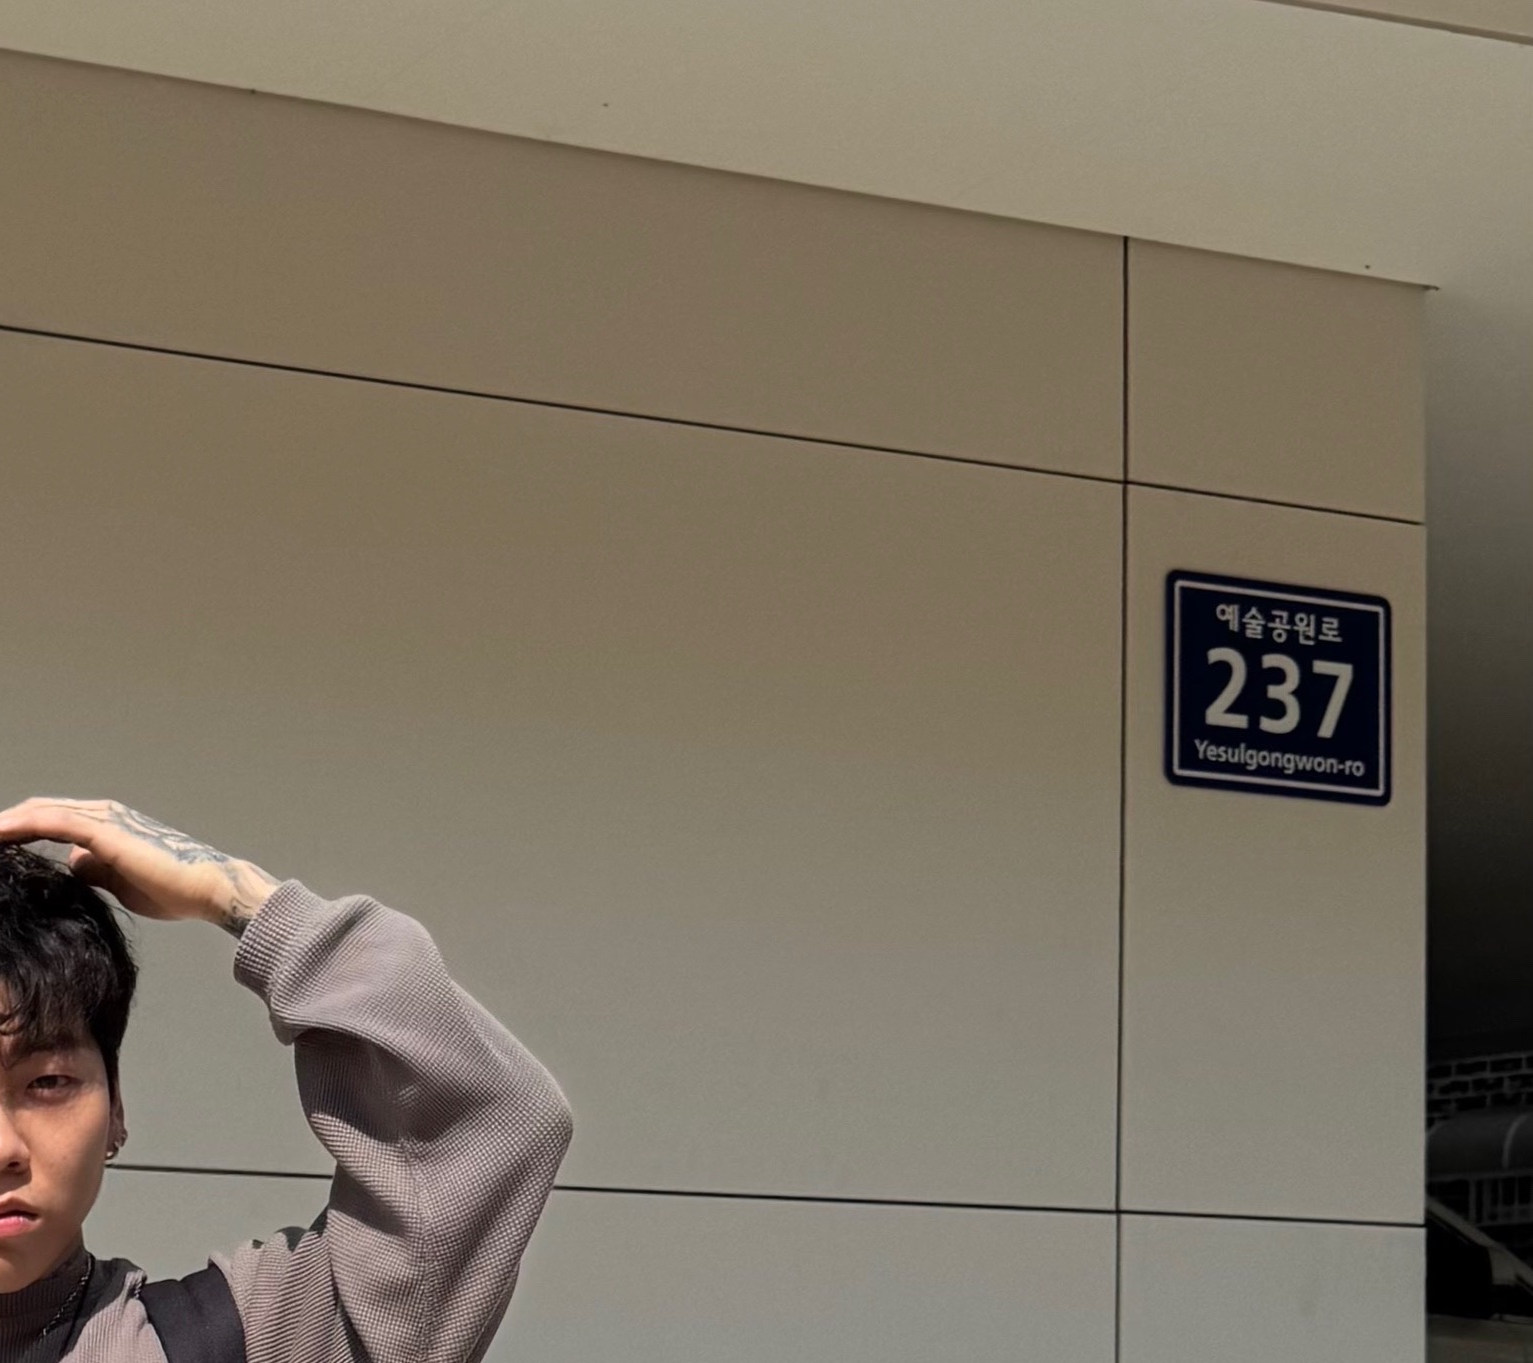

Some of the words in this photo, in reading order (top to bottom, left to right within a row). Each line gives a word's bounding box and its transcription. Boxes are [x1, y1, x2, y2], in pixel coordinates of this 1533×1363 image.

[1215, 603, 1343, 646] 예술공원로
[1205, 647, 1354, 739] 237
[1193, 739, 1365, 777] Yesulgongwon-ro
